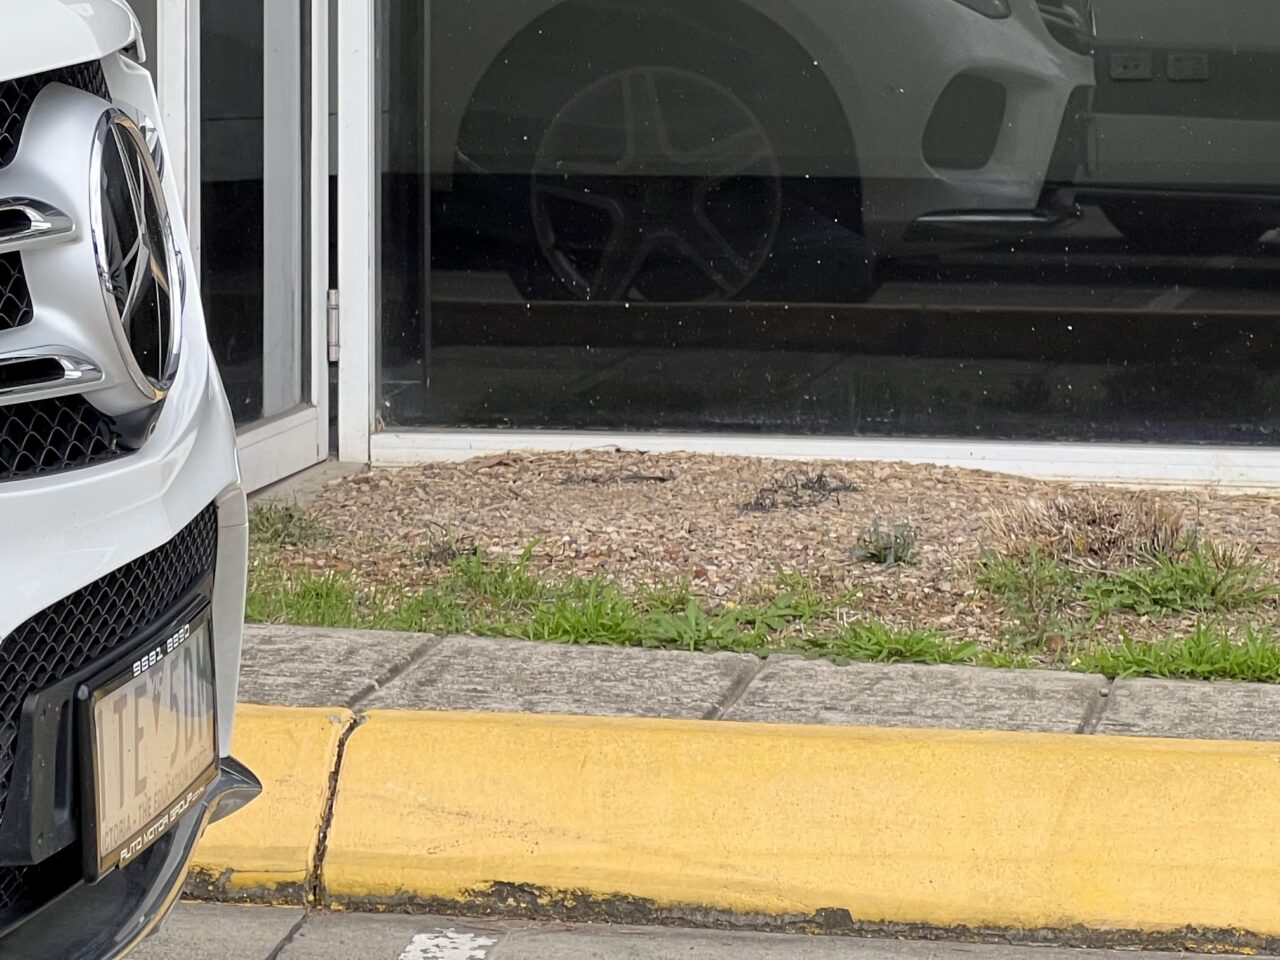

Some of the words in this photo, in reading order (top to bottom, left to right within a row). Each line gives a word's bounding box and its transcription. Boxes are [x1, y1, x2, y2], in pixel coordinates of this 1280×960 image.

[120, 836, 143, 863] AUTO
[143, 814, 169, 845] MOTOR
[169, 791, 193, 823] GROUP
